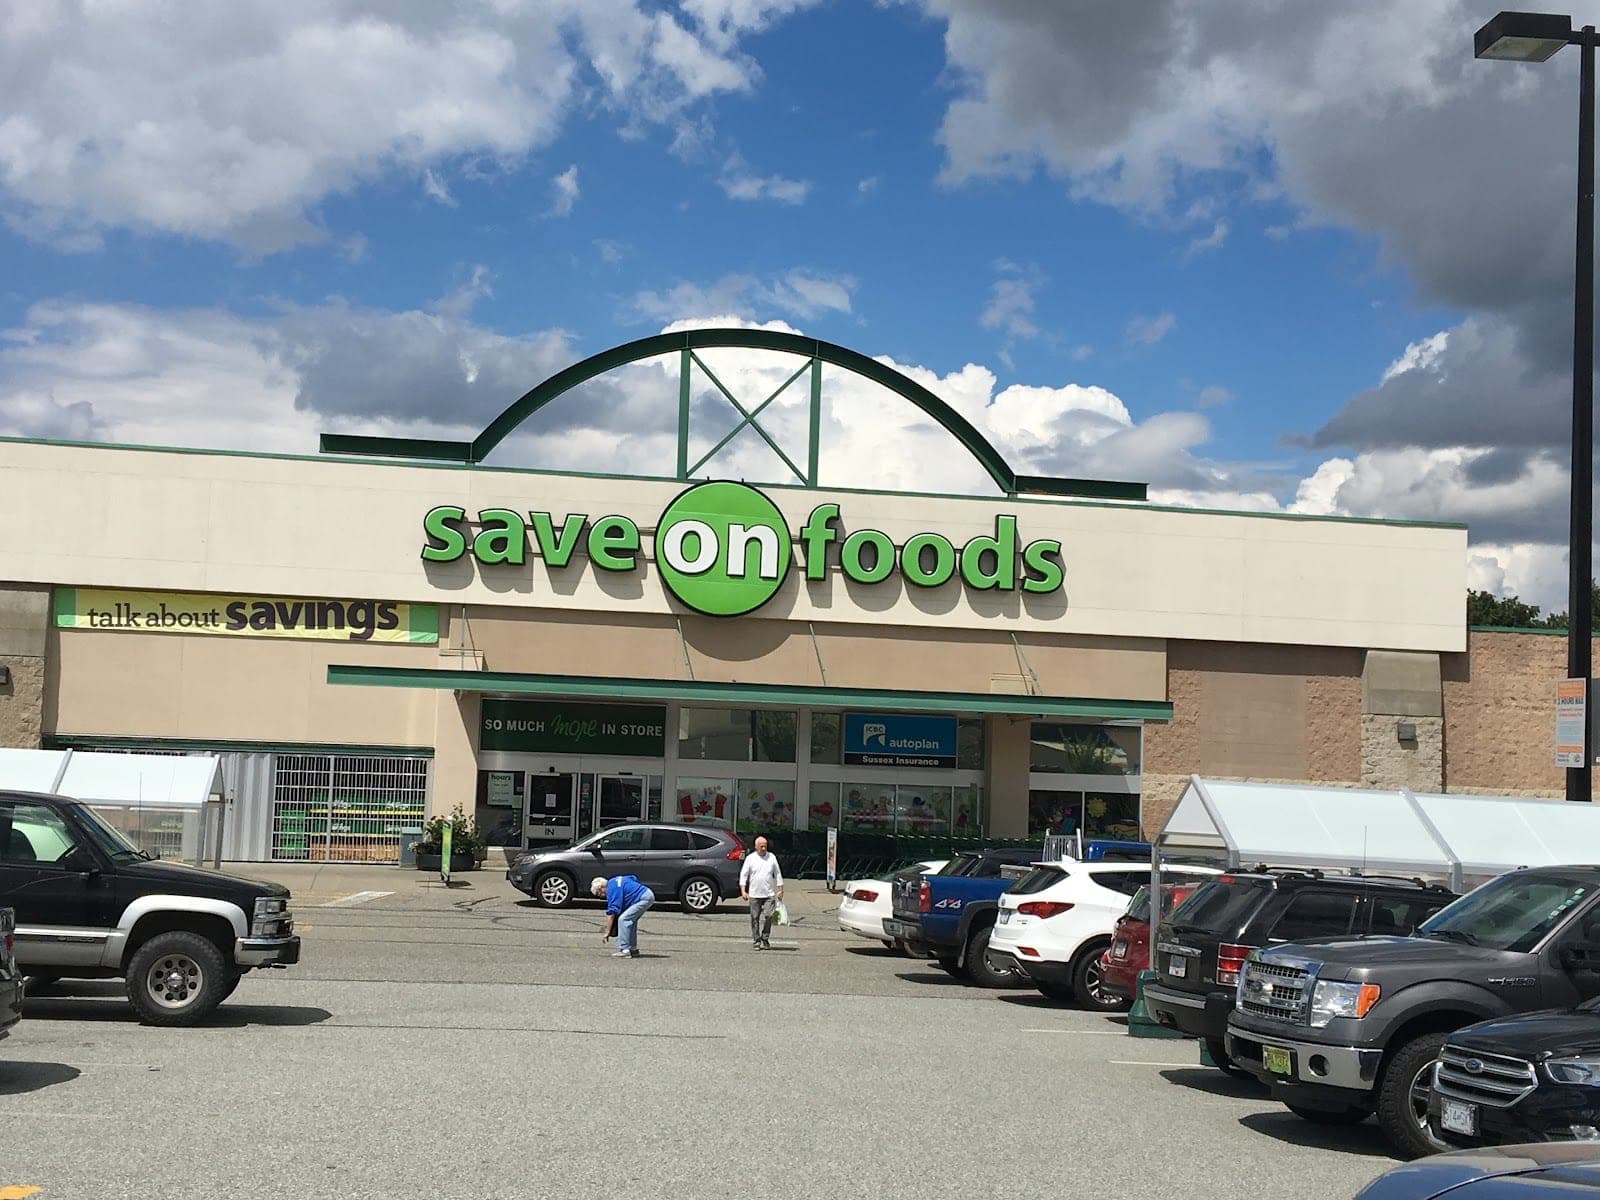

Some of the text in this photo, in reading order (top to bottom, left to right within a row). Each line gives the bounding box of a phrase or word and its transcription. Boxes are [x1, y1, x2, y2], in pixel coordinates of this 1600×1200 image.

[421, 502, 1064, 593] save on foods
[88, 600, 400, 641] talk about savings
[484, 714, 663, 742] SO MUCH more IN STORE
[889, 738, 939, 751] autoplan
[862, 755, 939, 766] Sussex Insurance
[544, 827, 555, 836] IN
